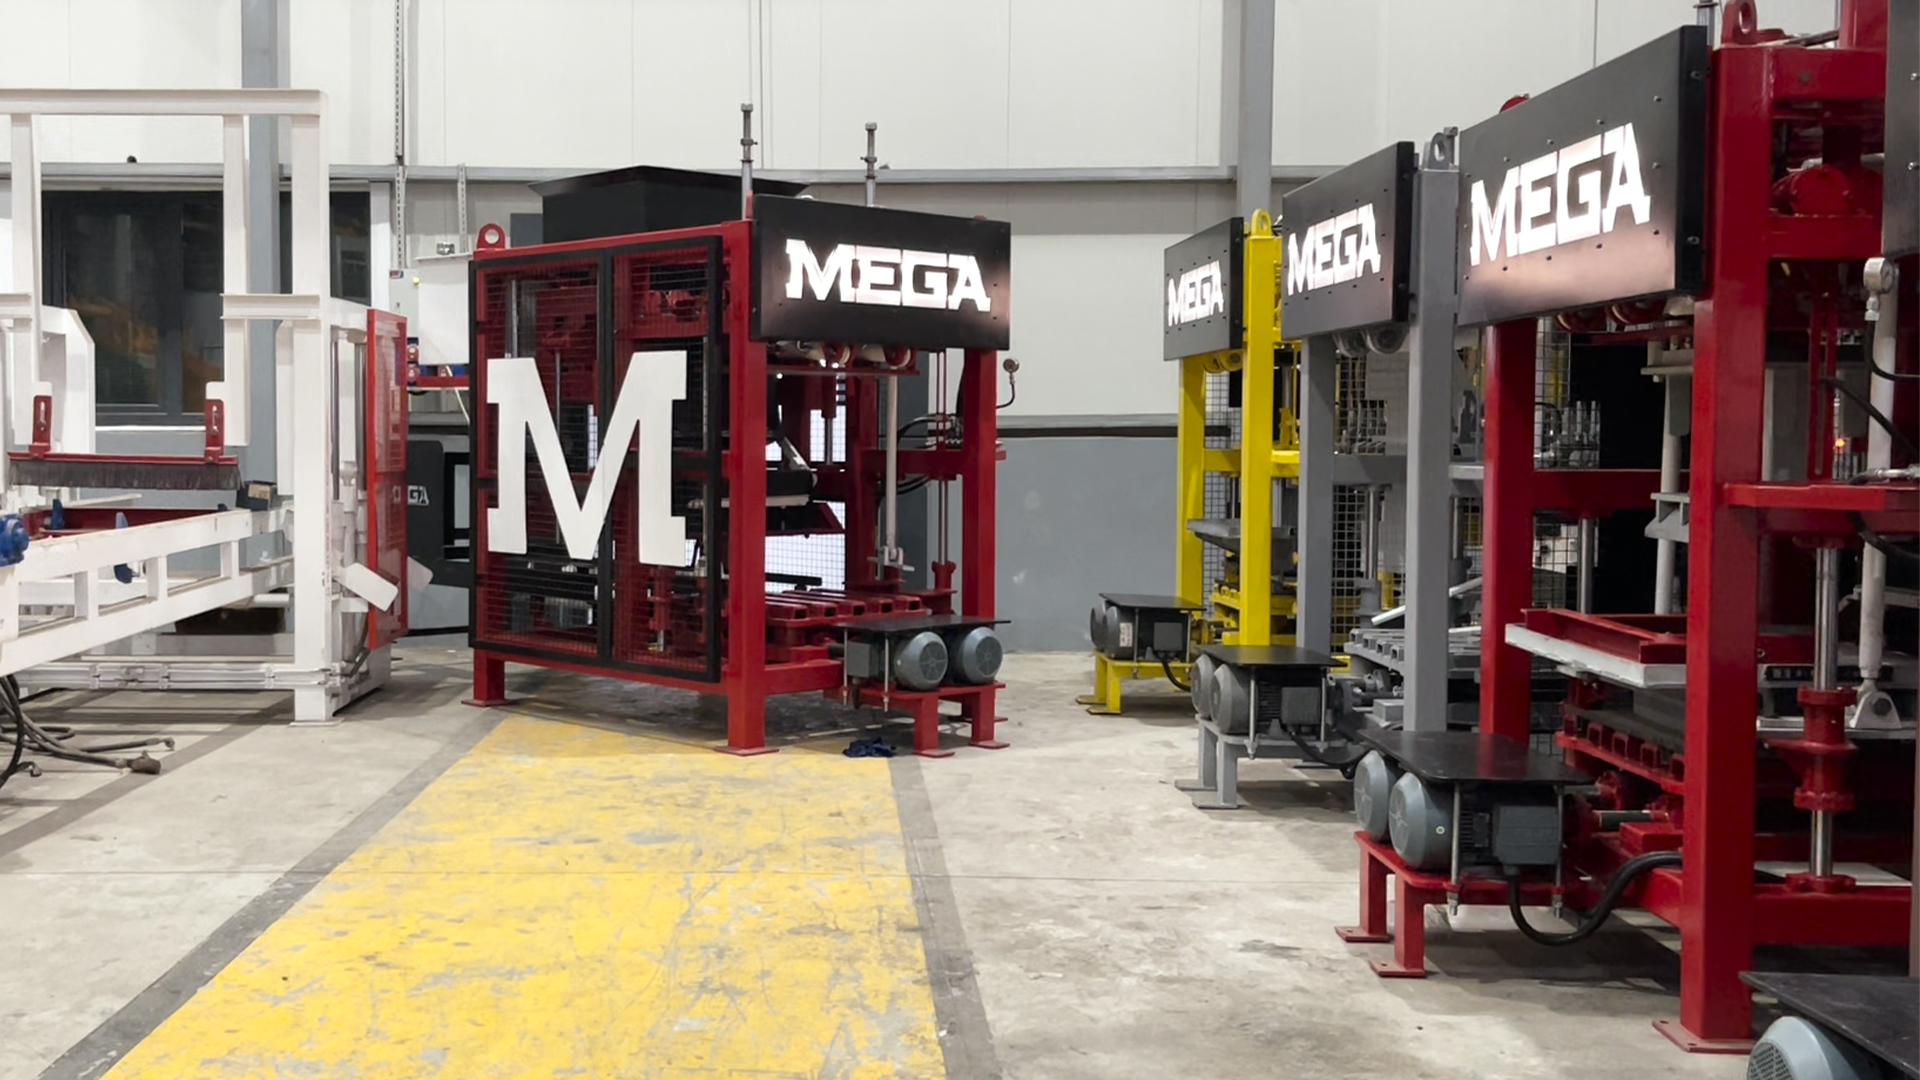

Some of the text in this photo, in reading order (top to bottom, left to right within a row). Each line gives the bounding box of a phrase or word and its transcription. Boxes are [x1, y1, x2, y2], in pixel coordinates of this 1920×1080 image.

[1470, 123, 1650, 266] MEGA
[785, 238, 991, 312] MEGA
[1167, 260, 1224, 327] MEGA
[1287, 203, 1381, 296] MEGA
[487, 351, 686, 566] M
